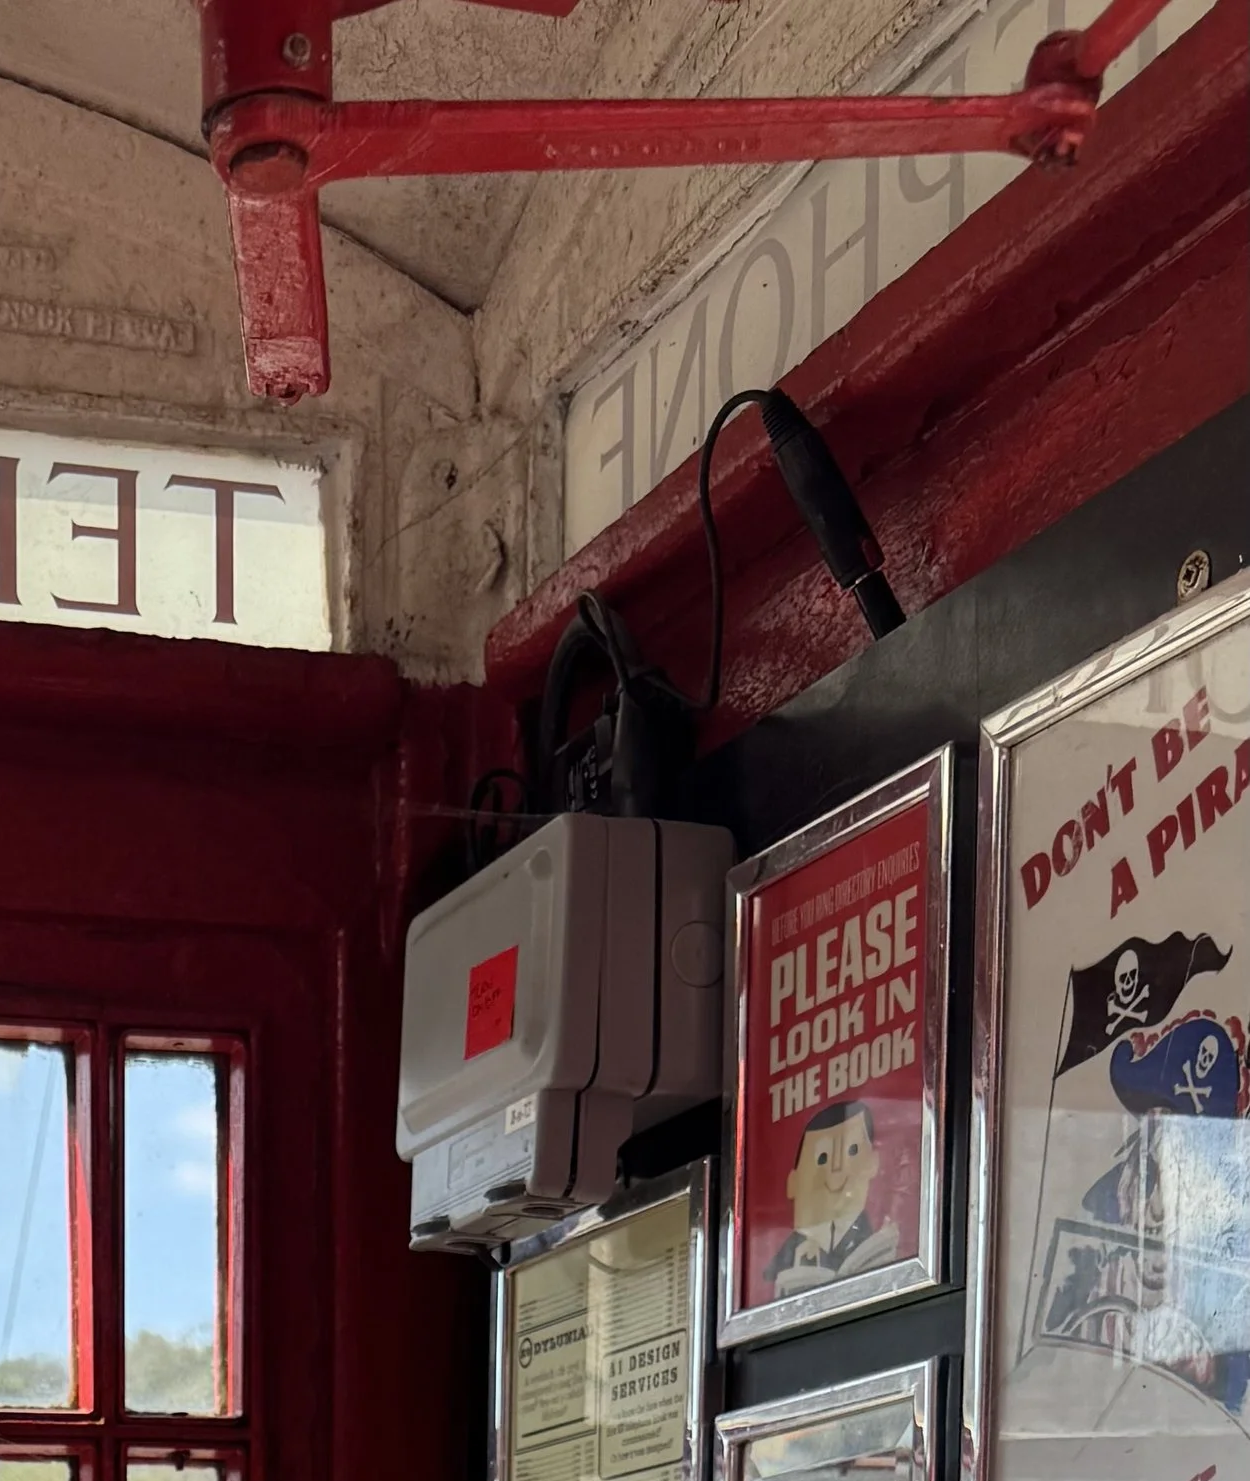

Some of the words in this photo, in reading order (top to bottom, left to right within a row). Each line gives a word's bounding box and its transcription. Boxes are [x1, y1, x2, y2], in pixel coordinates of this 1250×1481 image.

[1020, 756, 1138, 911] DON'T
[1151, 686, 1212, 783] BE
[835, 864, 876, 912] DIRECTORY
[1110, 857, 1139, 919] A
[770, 885, 918, 1028] PLEASE
[769, 996, 866, 1076] LOOK
[875, 970, 916, 1028] IN
[769, 1072, 821, 1123] THE
[827, 1022, 916, 1101] BOOK
[611, 1366, 678, 1401] SERVICES
[629, 1340, 681, 1373] DESIGN
